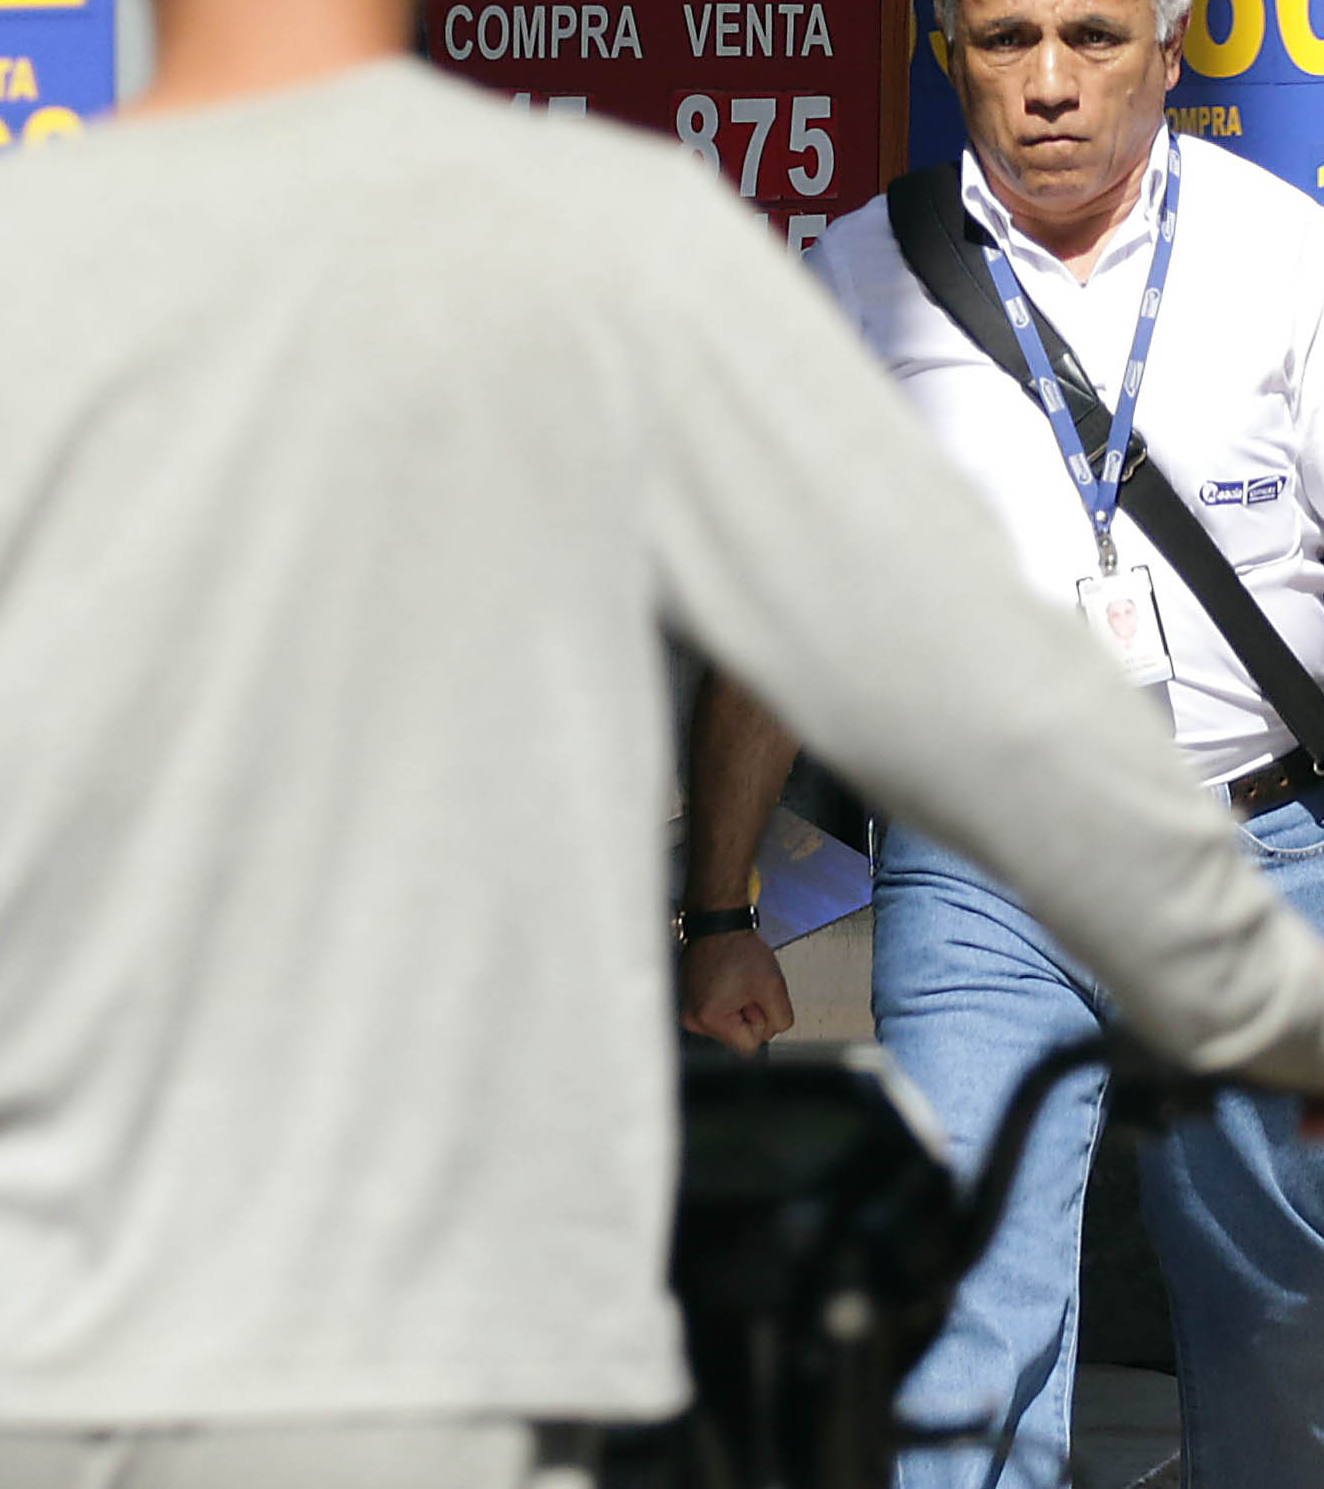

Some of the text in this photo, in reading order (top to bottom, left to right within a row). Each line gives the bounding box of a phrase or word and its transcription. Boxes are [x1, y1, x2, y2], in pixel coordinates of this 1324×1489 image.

[444, 3, 834, 61] COMPRA VENTA
[675, 94, 835, 198] 875
